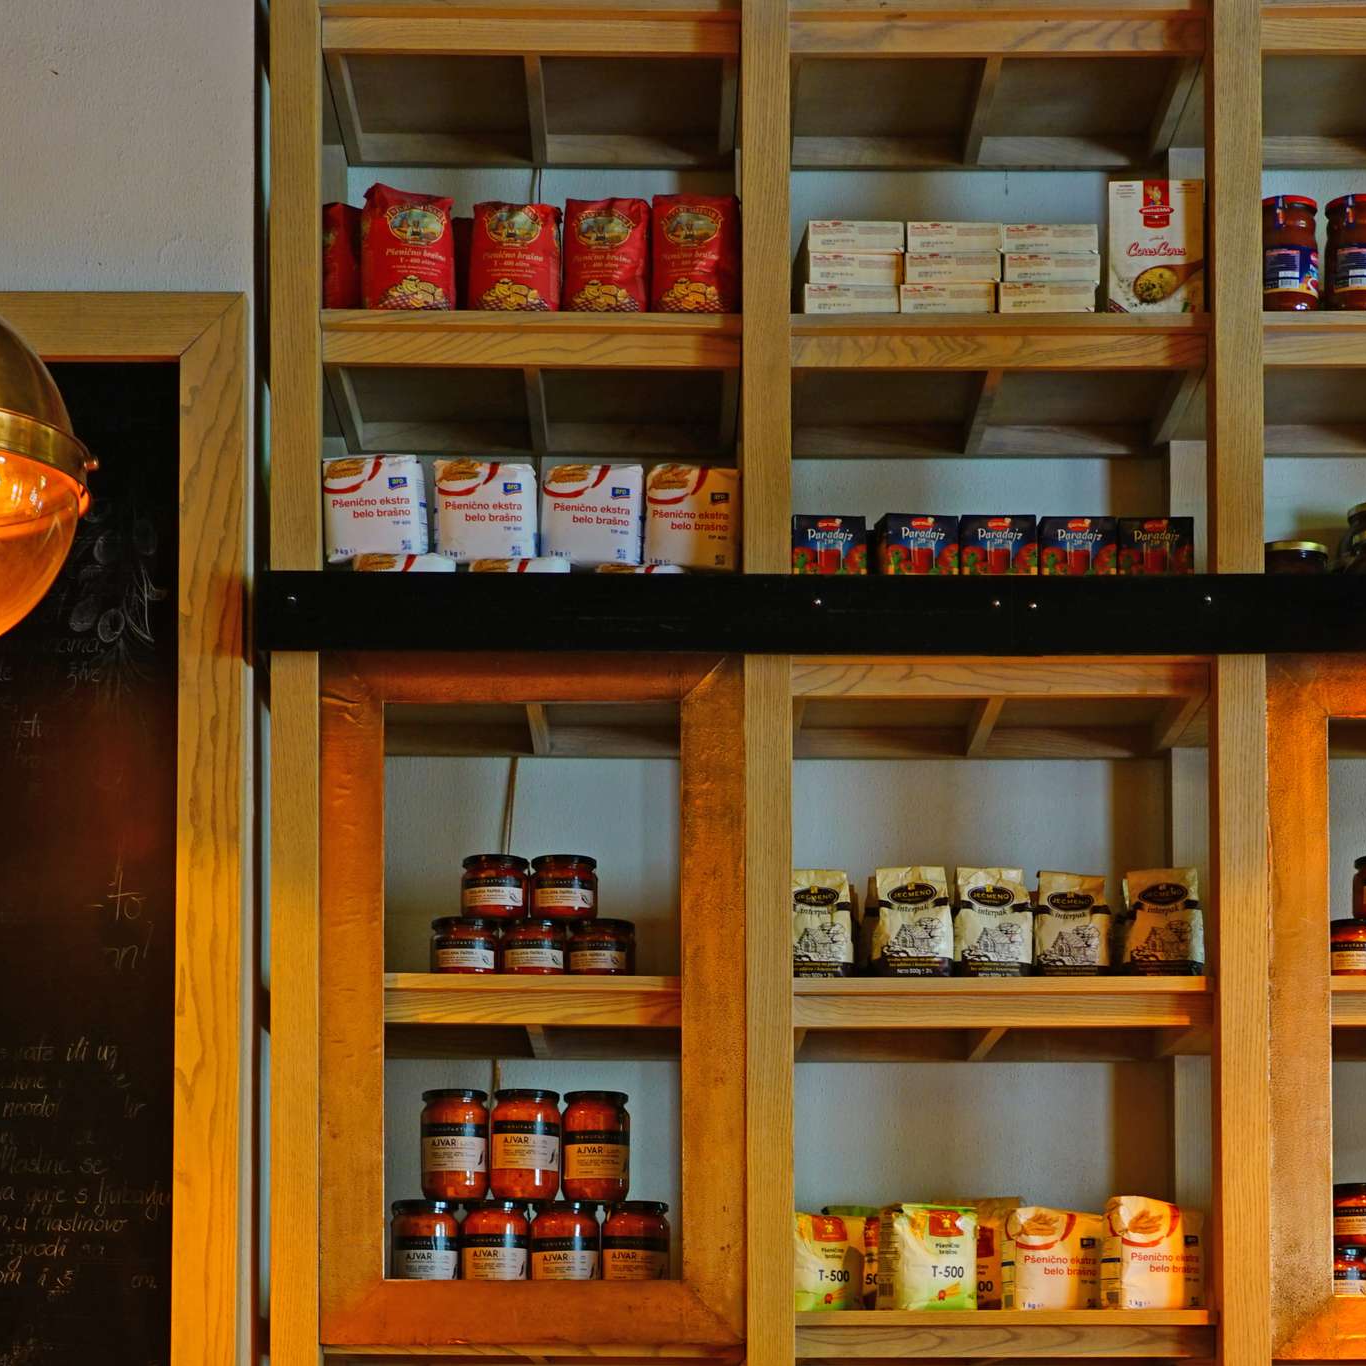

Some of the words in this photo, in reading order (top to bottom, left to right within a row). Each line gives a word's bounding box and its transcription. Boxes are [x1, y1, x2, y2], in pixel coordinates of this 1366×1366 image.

[332, 498, 377, 508] Pšenično
[379, 497, 410, 506] ekstra
[444, 501, 490, 510] Pšenično
[492, 502, 522, 511] ekstra
[353, 510, 375, 519] belo
[376, 508, 411, 517] brašno
[553, 503, 597, 513] Pšenično
[600, 505, 630, 515] ekstra
[465, 513, 486, 522] belo
[488, 512, 522, 522] brašno
[652, 509, 696, 519] Pšenično
[699, 512, 730, 520] ekstra
[572, 516, 594, 524] belo
[596, 516, 629, 527] brašno
[670, 521, 692, 530] belo
[694, 522, 728, 532] brašno
[808, 528, 853, 545] Paradajz
[902, 527, 945, 544] Paradajz
[978, 528, 1023, 543] Paradajz
[1057, 529, 1102, 543] Paradajz
[1134, 530, 1180, 544] Paradajz
[431, 1138, 457, 1147] AJVAR
[504, 1136, 530, 1144] AJVAR
[577, 1146, 603, 1154] AJVAR
[406, 1252, 432, 1261] AJVAR
[473, 1248, 498, 1257] AJVAR
[543, 1253, 568, 1262] AJVAR
[611, 1251, 637, 1260] AJVAR
[1131, 1252, 1173, 1262] Pšenično
[1024, 1255, 1068, 1265] Pšenično
[1070, 1256, 1096, 1265] ekstra
[931, 1265, 965, 1278] T-500
[1044, 1266, 1064, 1275] belo
[1150, 1264, 1170, 1273] belo
[818, 1269, 850, 1282] T-500
